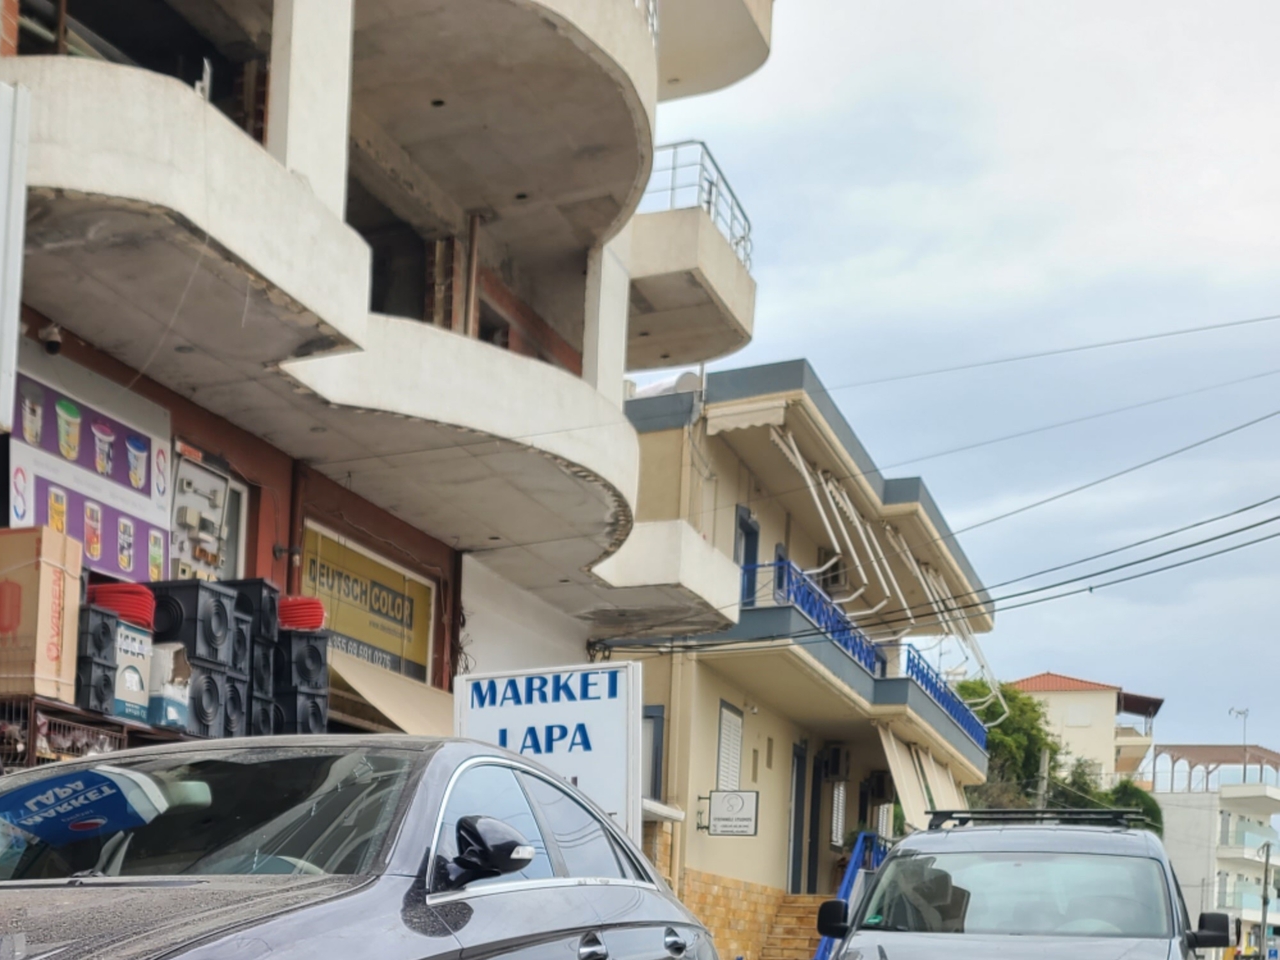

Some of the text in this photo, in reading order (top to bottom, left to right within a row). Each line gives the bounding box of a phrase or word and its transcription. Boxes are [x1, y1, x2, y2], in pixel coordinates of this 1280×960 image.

[50, 569, 63, 641] VAREM
[309, 558, 412, 629] DEUTSCH COLOR
[470, 669, 621, 709] MARKET
